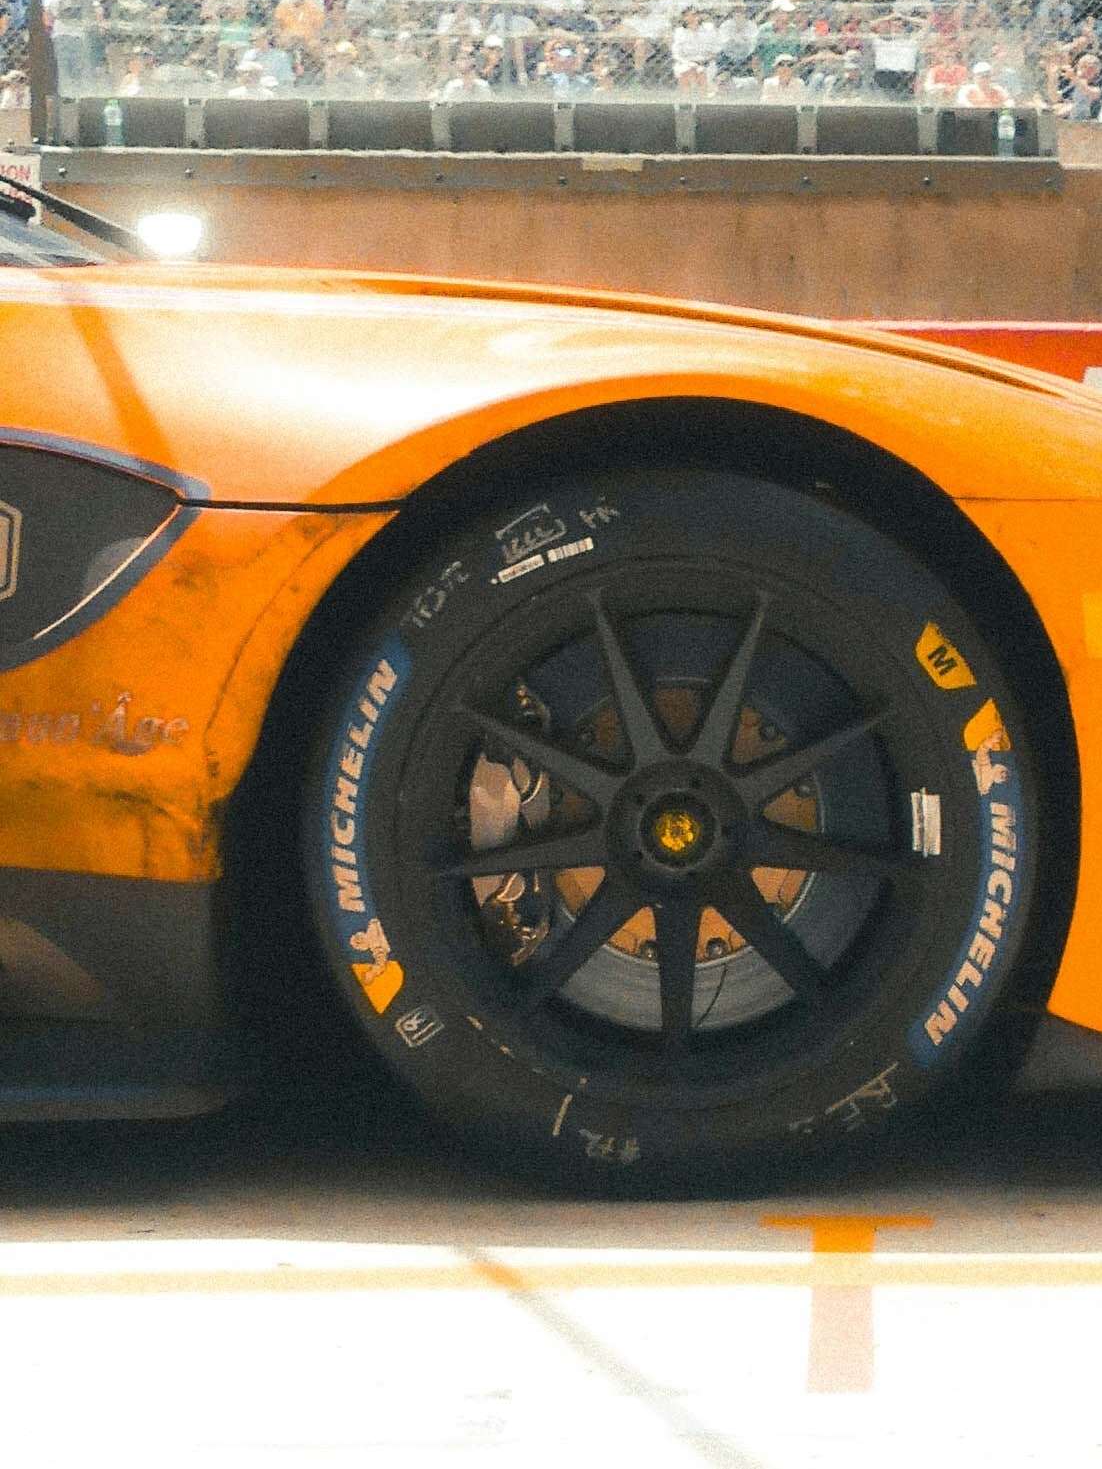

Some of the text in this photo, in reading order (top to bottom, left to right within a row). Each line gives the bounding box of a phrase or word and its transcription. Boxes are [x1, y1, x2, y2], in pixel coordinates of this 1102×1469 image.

[926, 644, 957, 677] M
[331, 658, 398, 914] MICHELIN
[923, 801, 1018, 1047] MICHELIN
